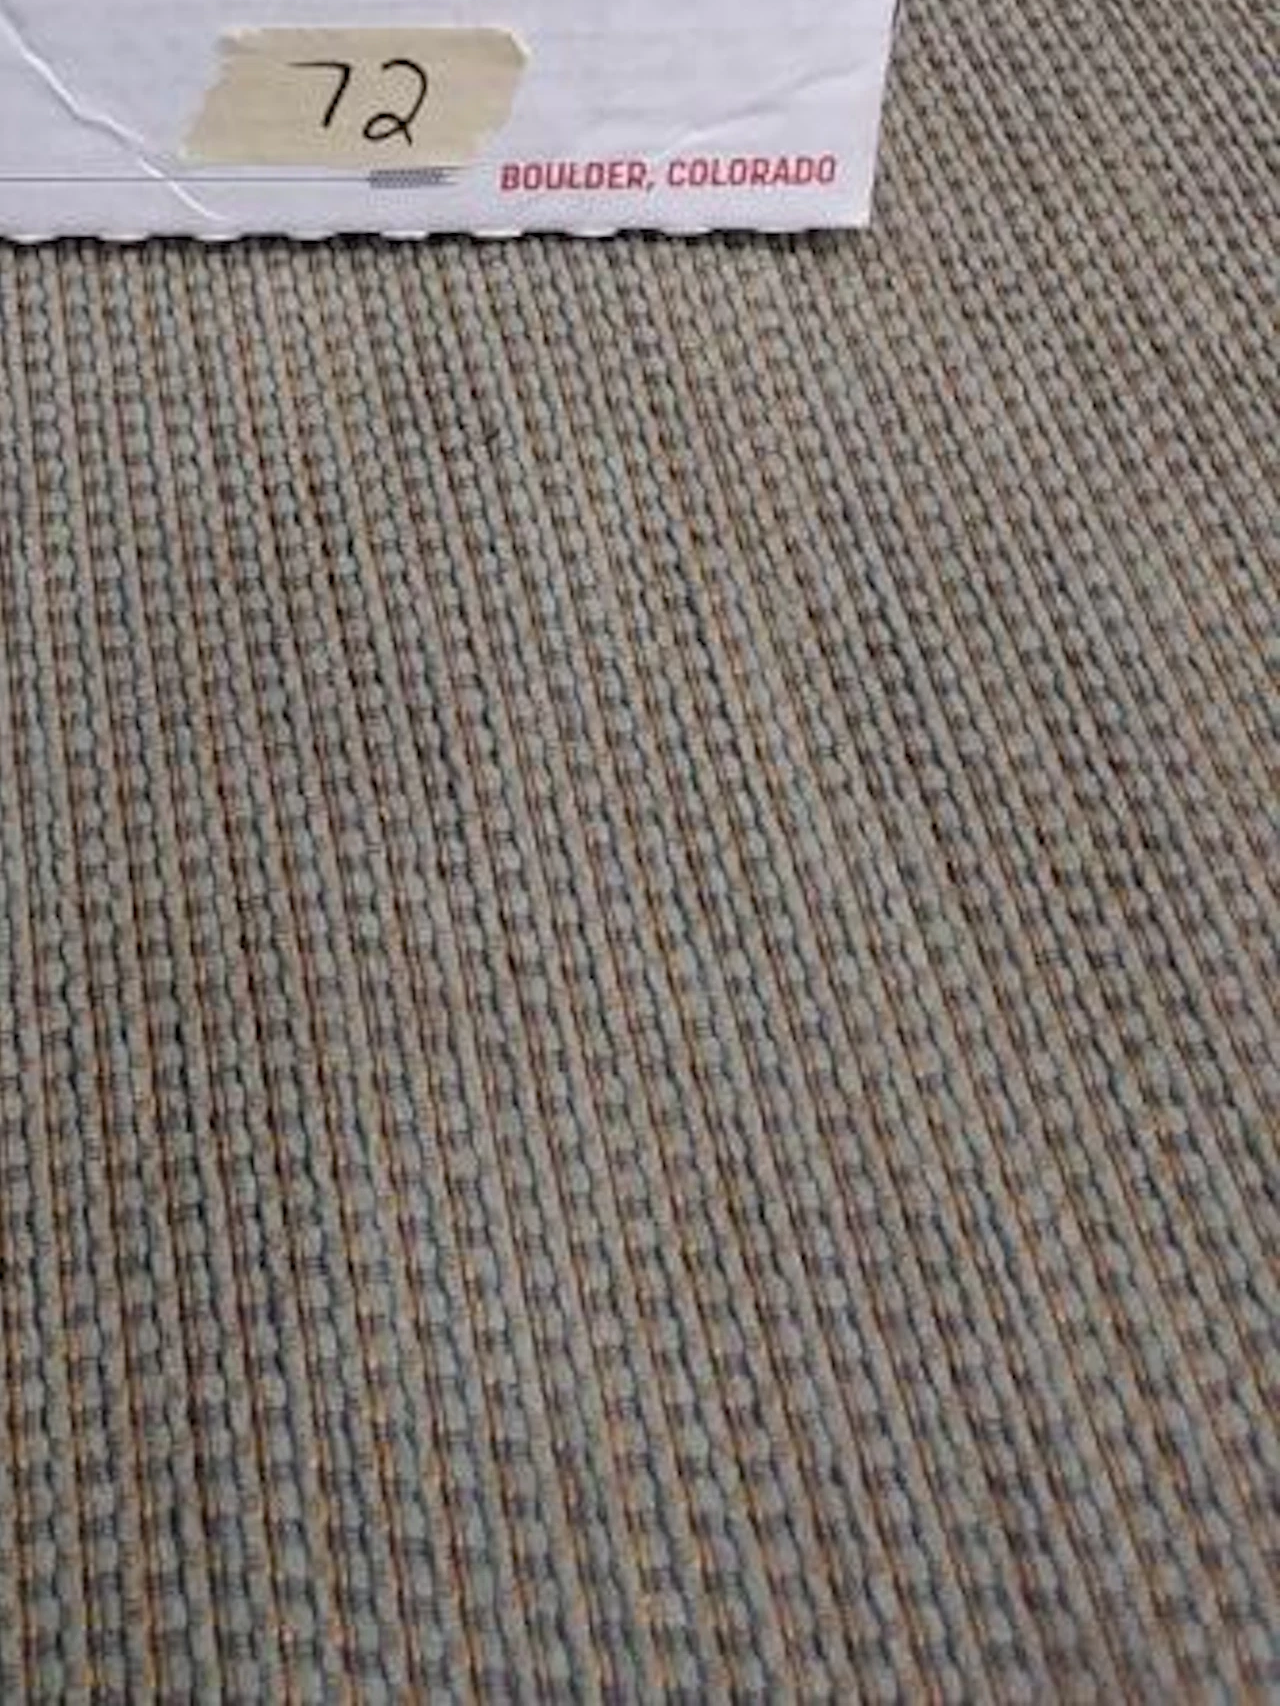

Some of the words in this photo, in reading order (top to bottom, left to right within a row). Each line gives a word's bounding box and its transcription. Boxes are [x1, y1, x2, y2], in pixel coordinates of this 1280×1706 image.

[289, 58, 430, 145] 72
[500, 160, 656, 194] BOULDER,
[667, 154, 838, 187] COLORADO
